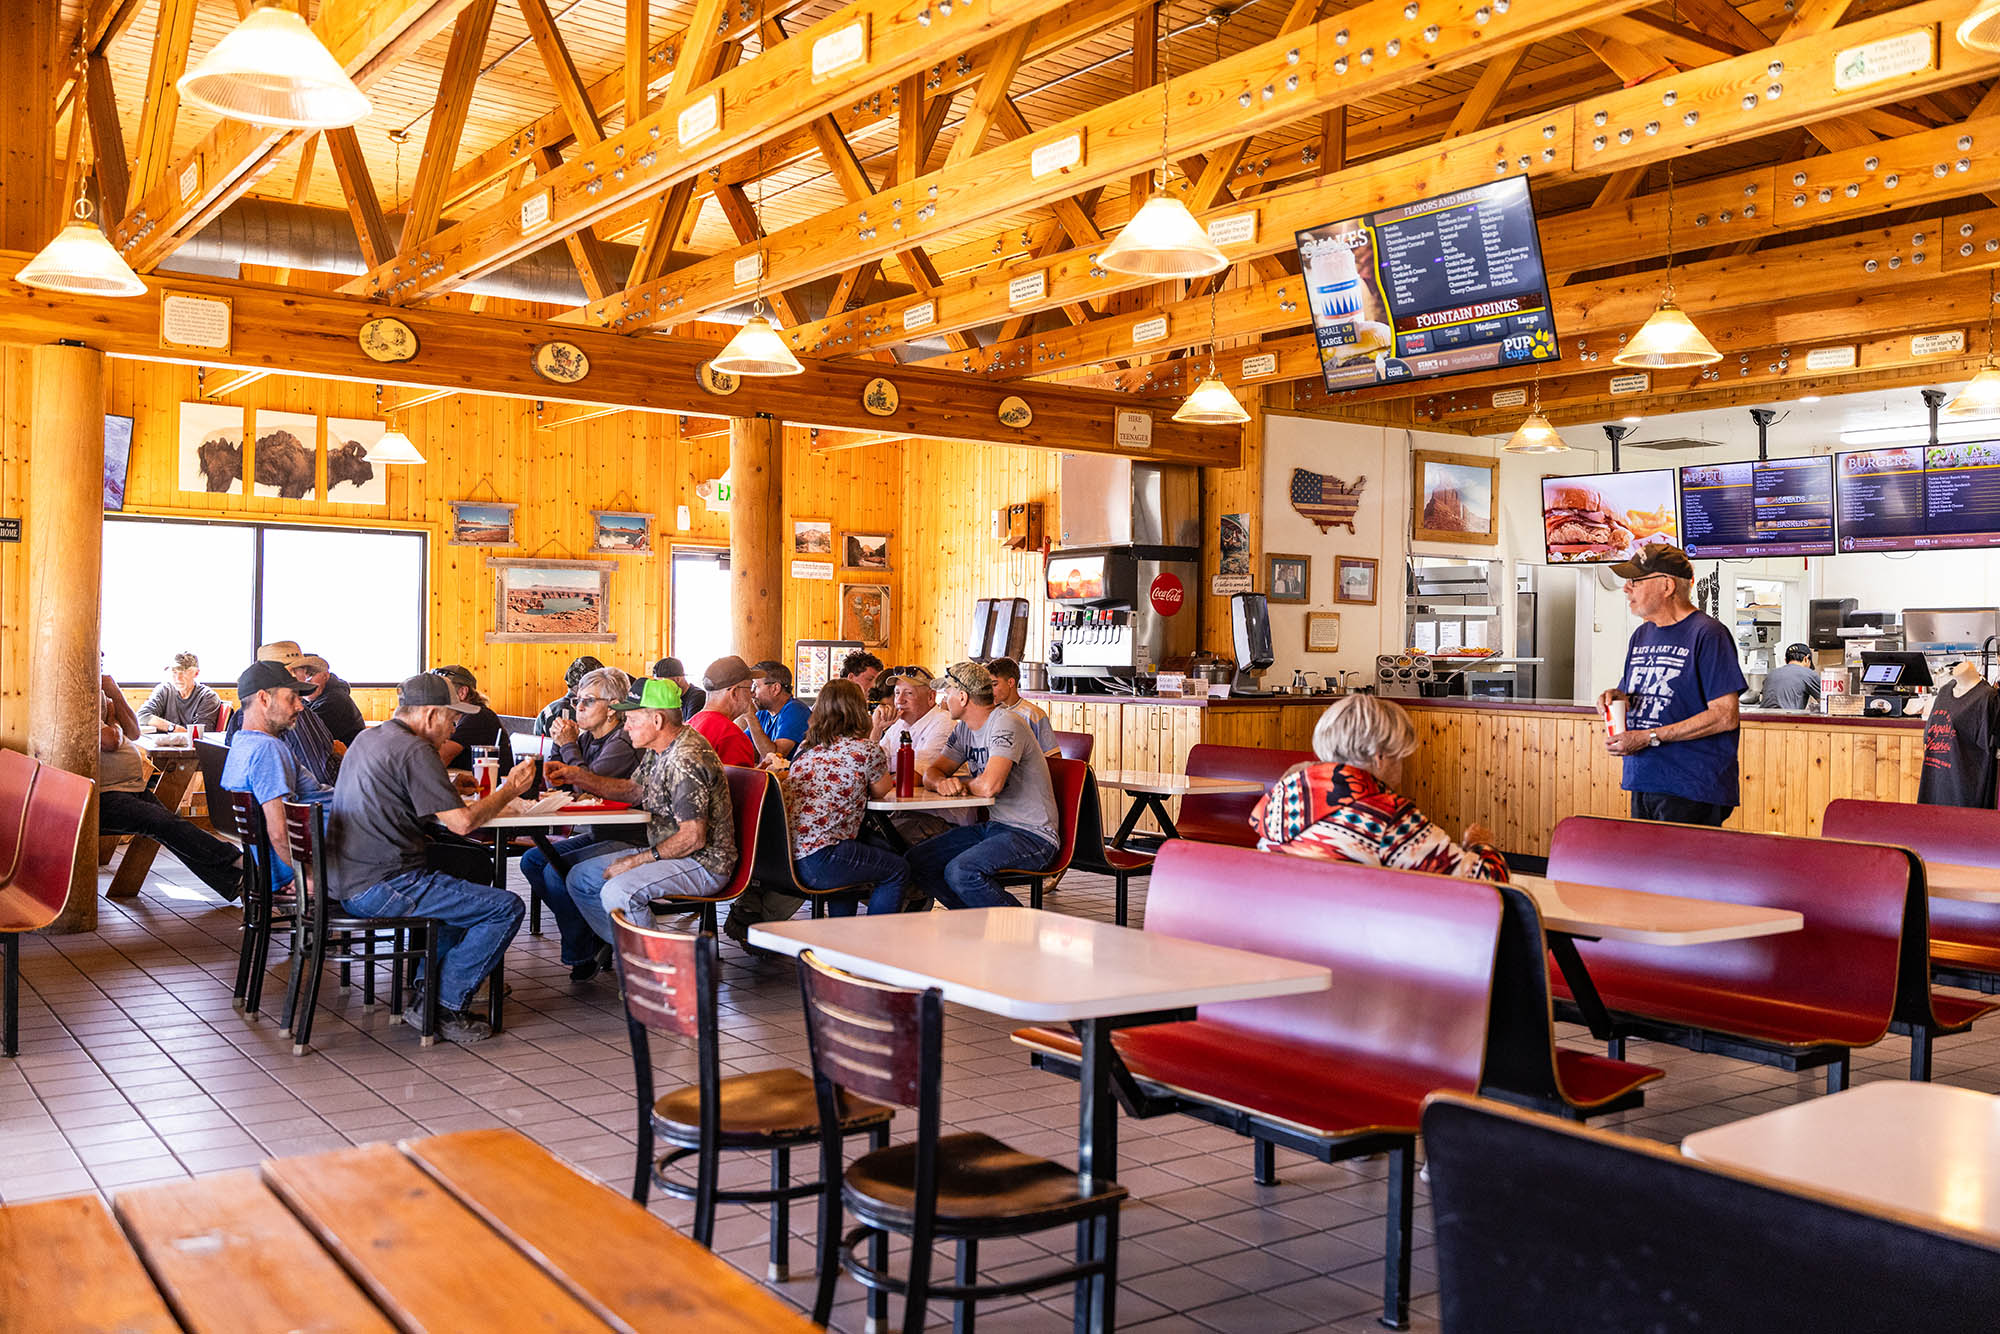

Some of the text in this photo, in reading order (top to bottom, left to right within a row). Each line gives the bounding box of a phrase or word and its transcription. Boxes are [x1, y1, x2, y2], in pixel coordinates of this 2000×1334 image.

[1404, 203, 1437, 216] FLAVORS
[1439, 196, 1456, 208] AND
[1438, 222, 1468, 233] Peanut Butter
[1416, 299, 1519, 327] FOUNTAIN DRINKS
[1517, 315, 1539, 325] Large
[1475, 321, 1501, 331] Medium
[1319, 327, 1340, 337] SMALL
[1320, 336, 1343, 347] LARGE
[1503, 335, 1531, 351] PUP
[1505, 349, 1530, 360] cups
[1120, 433, 1149, 441] TEENAGER
[1847, 452, 1911, 469] BURGERS
[1677, 647, 1689, 657] DO
[1628, 666, 1681, 697] FIX
